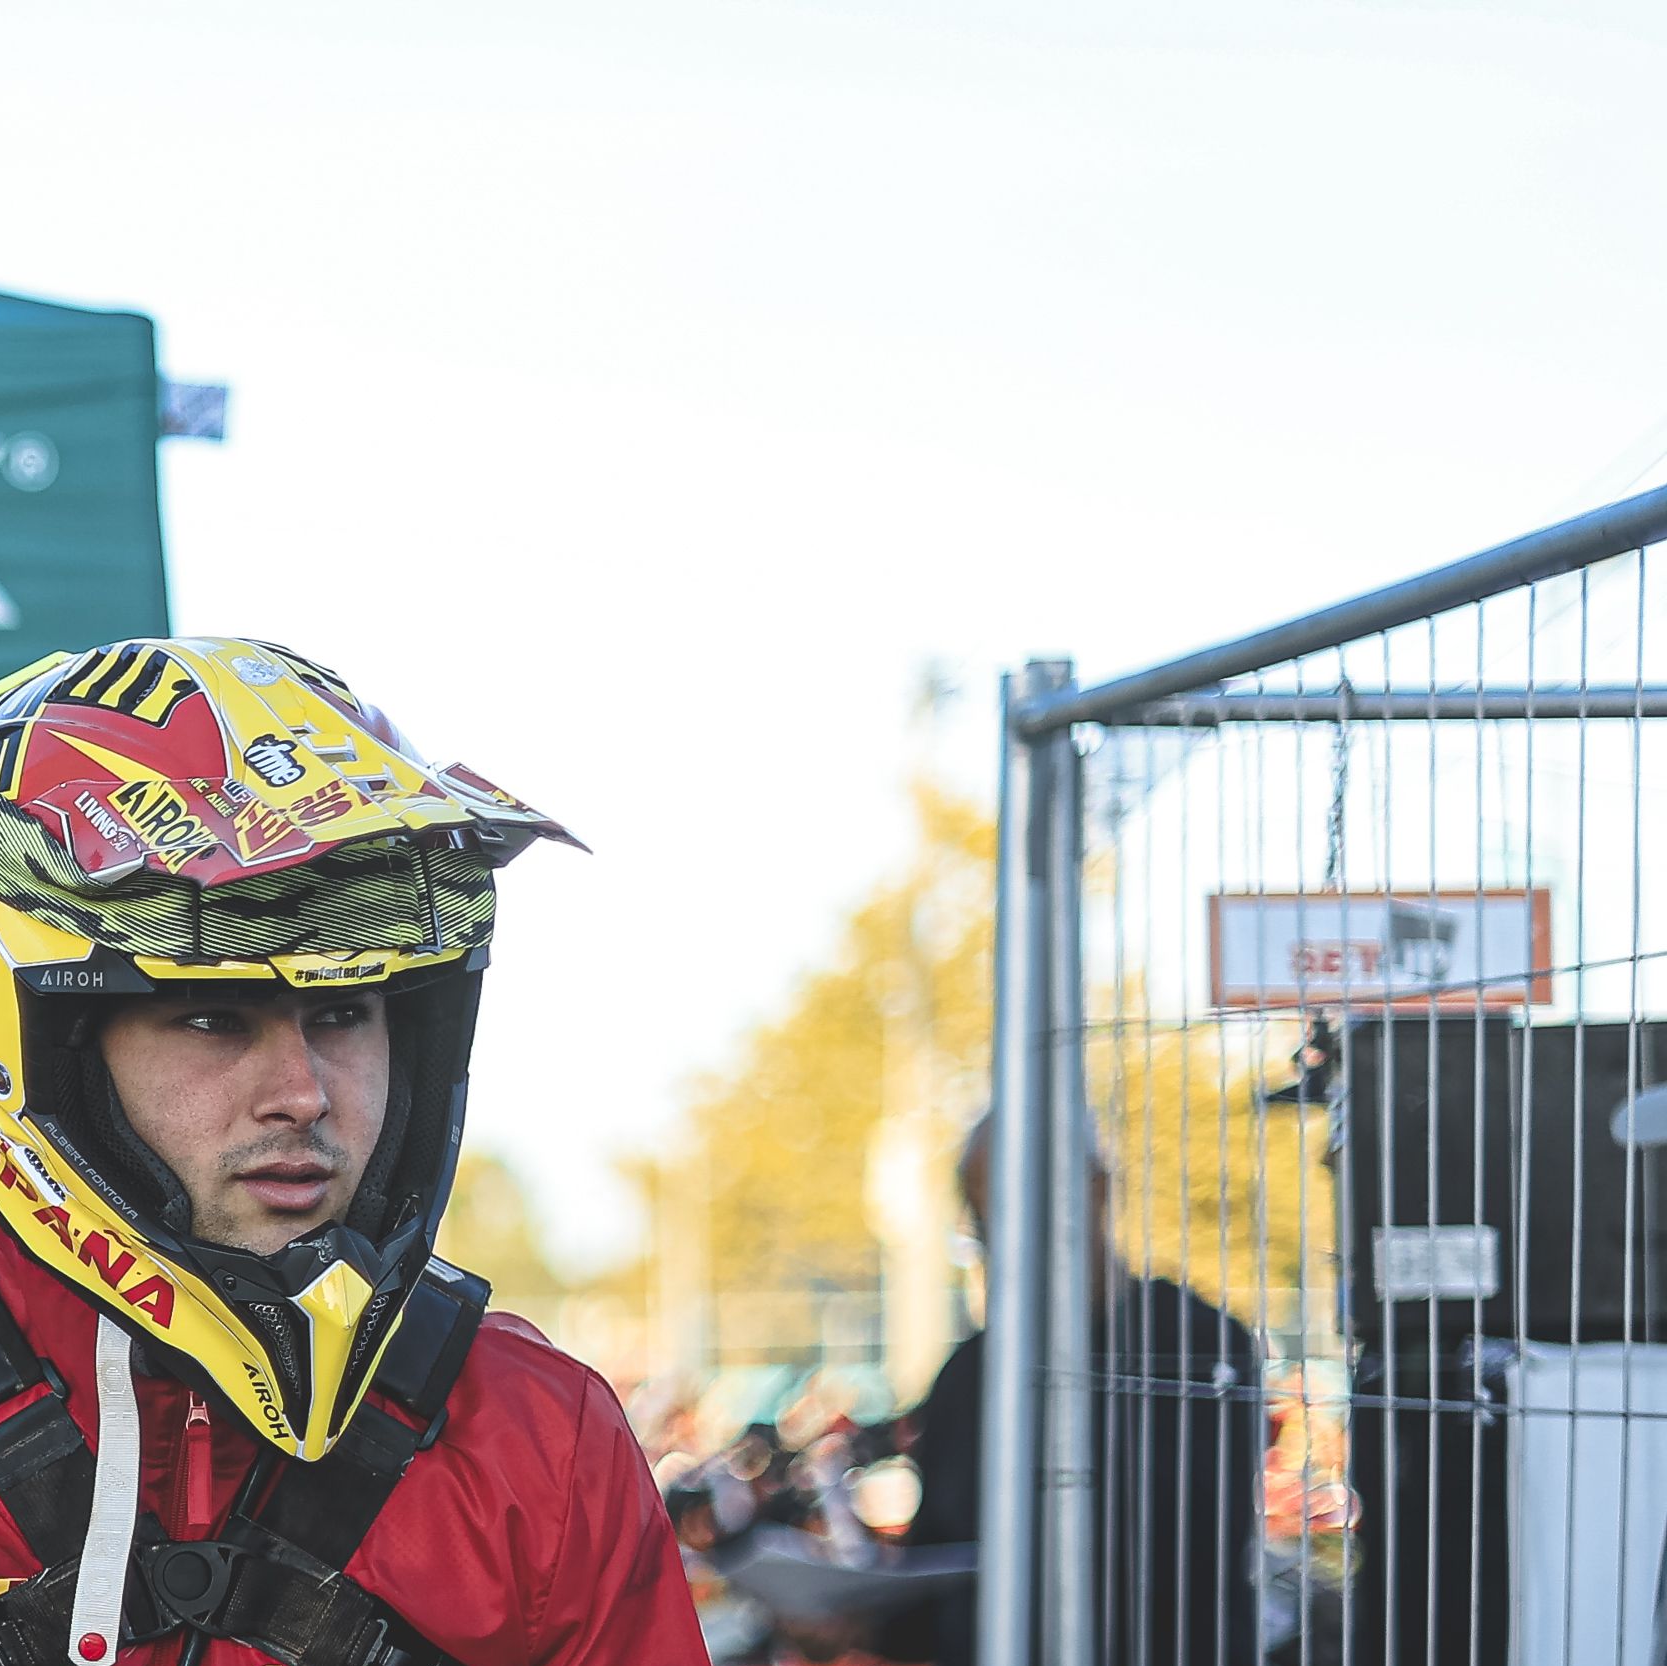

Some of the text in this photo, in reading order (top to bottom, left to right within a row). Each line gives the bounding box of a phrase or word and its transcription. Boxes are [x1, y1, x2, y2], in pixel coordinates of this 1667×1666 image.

[74, 791, 119, 839] LIVING
[40, 970, 104, 988] AIROH
[43, 1121, 139, 1220] ALBERT FONTOVA
[242, 1360, 289, 1440] AIROH
